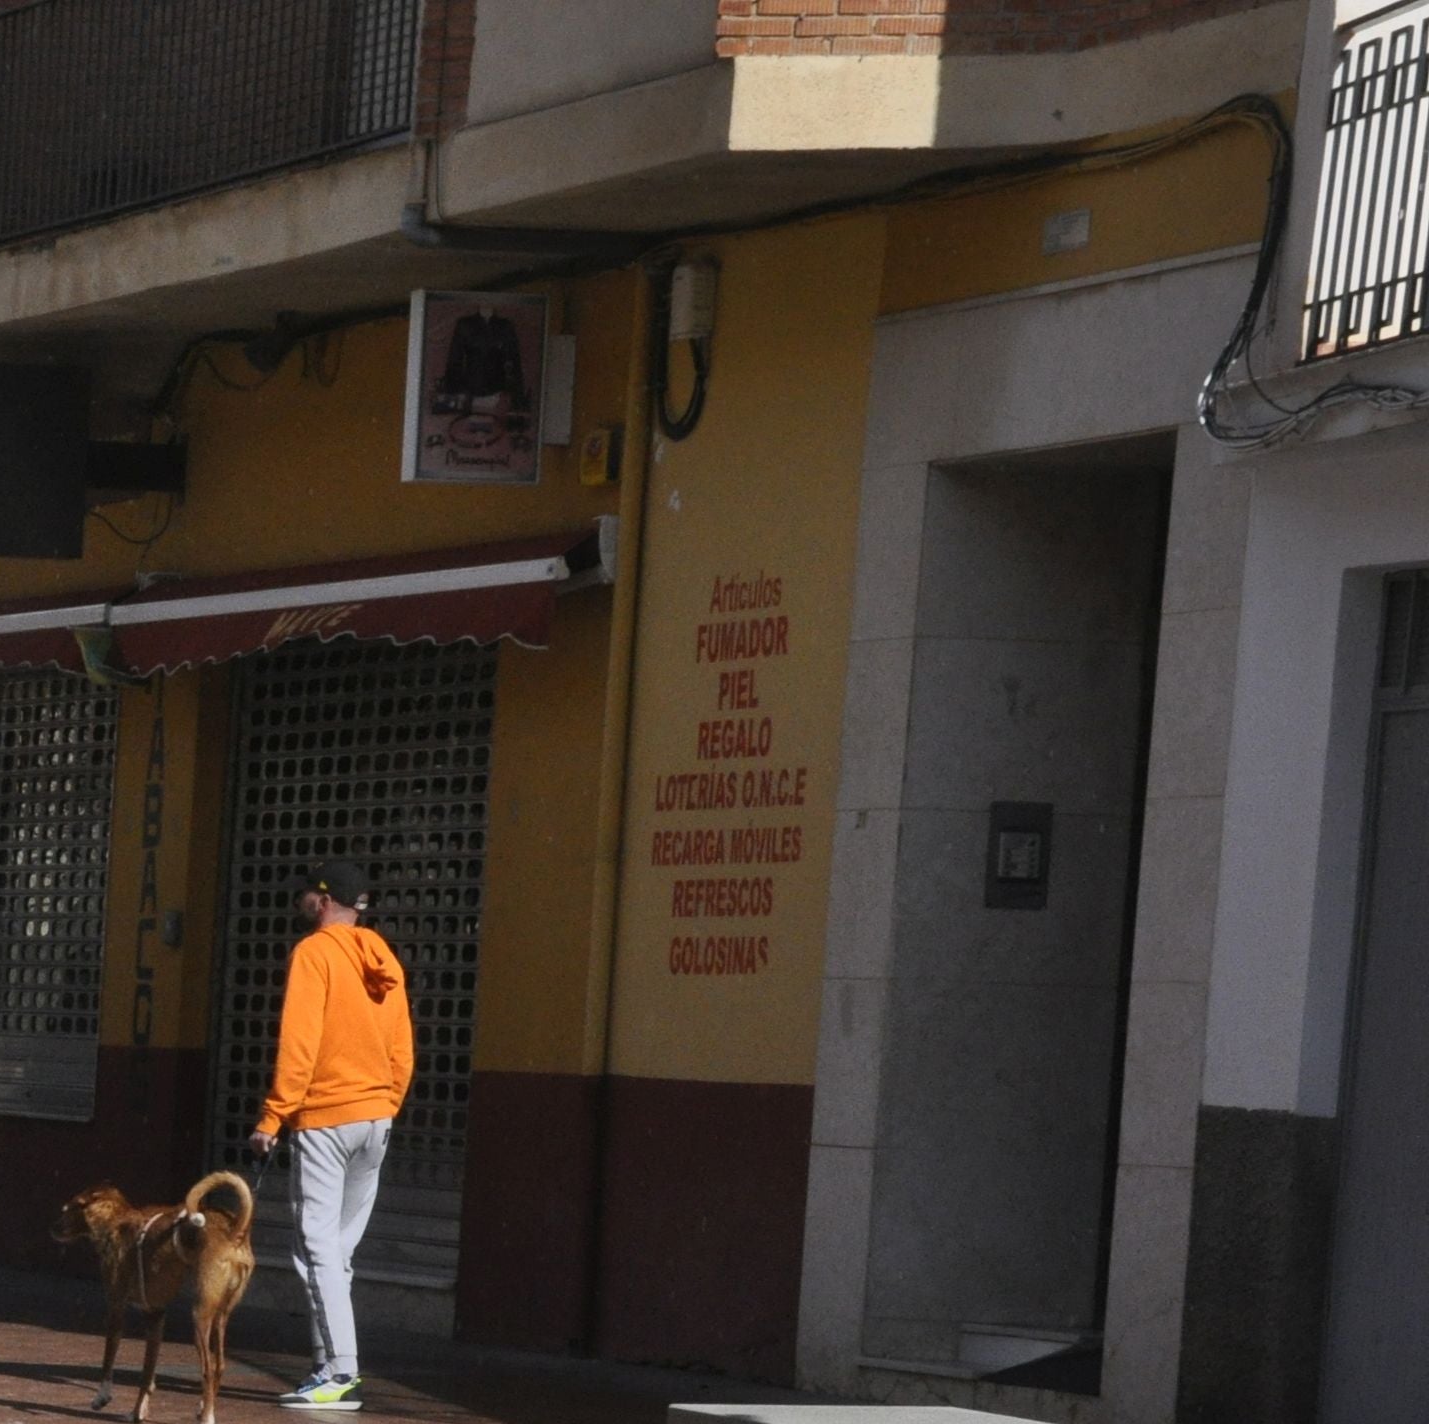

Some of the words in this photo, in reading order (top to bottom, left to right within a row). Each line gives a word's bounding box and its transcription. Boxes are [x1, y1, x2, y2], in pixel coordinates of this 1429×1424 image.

[709, 570, 783, 614] Artículos
[696, 615, 790, 664] FUMADOR
[718, 669, 759, 711] PIEL
[697, 716, 773, 761] REGALO
[655, 764, 738, 812] LOTERÍAS
[651, 828, 725, 867] RECARGA
[728, 818, 803, 865] MÓVILES
[672, 876, 774, 918] REFRESCOS
[669, 936, 769, 976] GOLOSINAS
